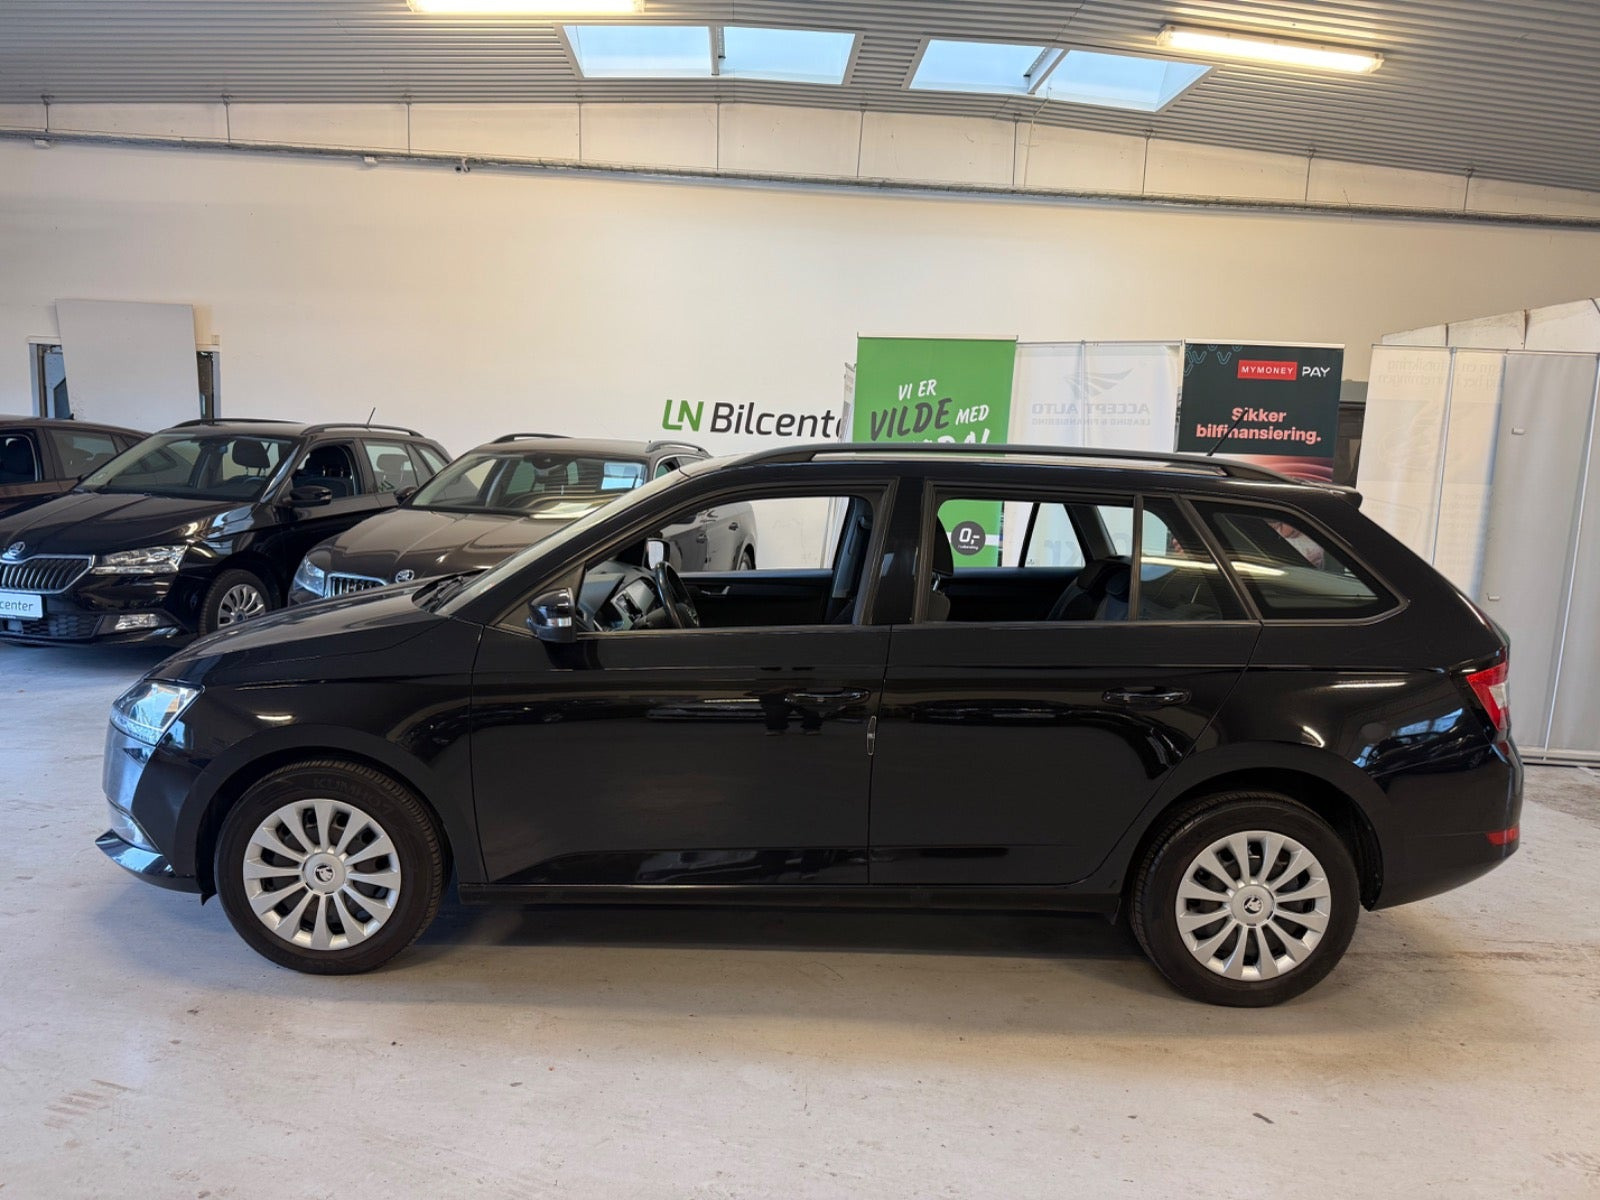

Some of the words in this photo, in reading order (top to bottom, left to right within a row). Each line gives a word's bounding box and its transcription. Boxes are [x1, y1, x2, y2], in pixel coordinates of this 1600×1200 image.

[1241, 366, 1295, 376] MYMONEY
[1302, 366, 1331, 378] PAY
[898, 383, 913, 401] VI
[917, 379, 937, 397] ER
[662, 399, 705, 432] LN
[870, 397, 953, 441] VILDE
[955, 404, 989, 426] MED
[1231, 407, 1287, 423] Sikker
[1196, 424, 1322, 445] bilfinansiering.
[958, 527, 981, 546] 0,-
